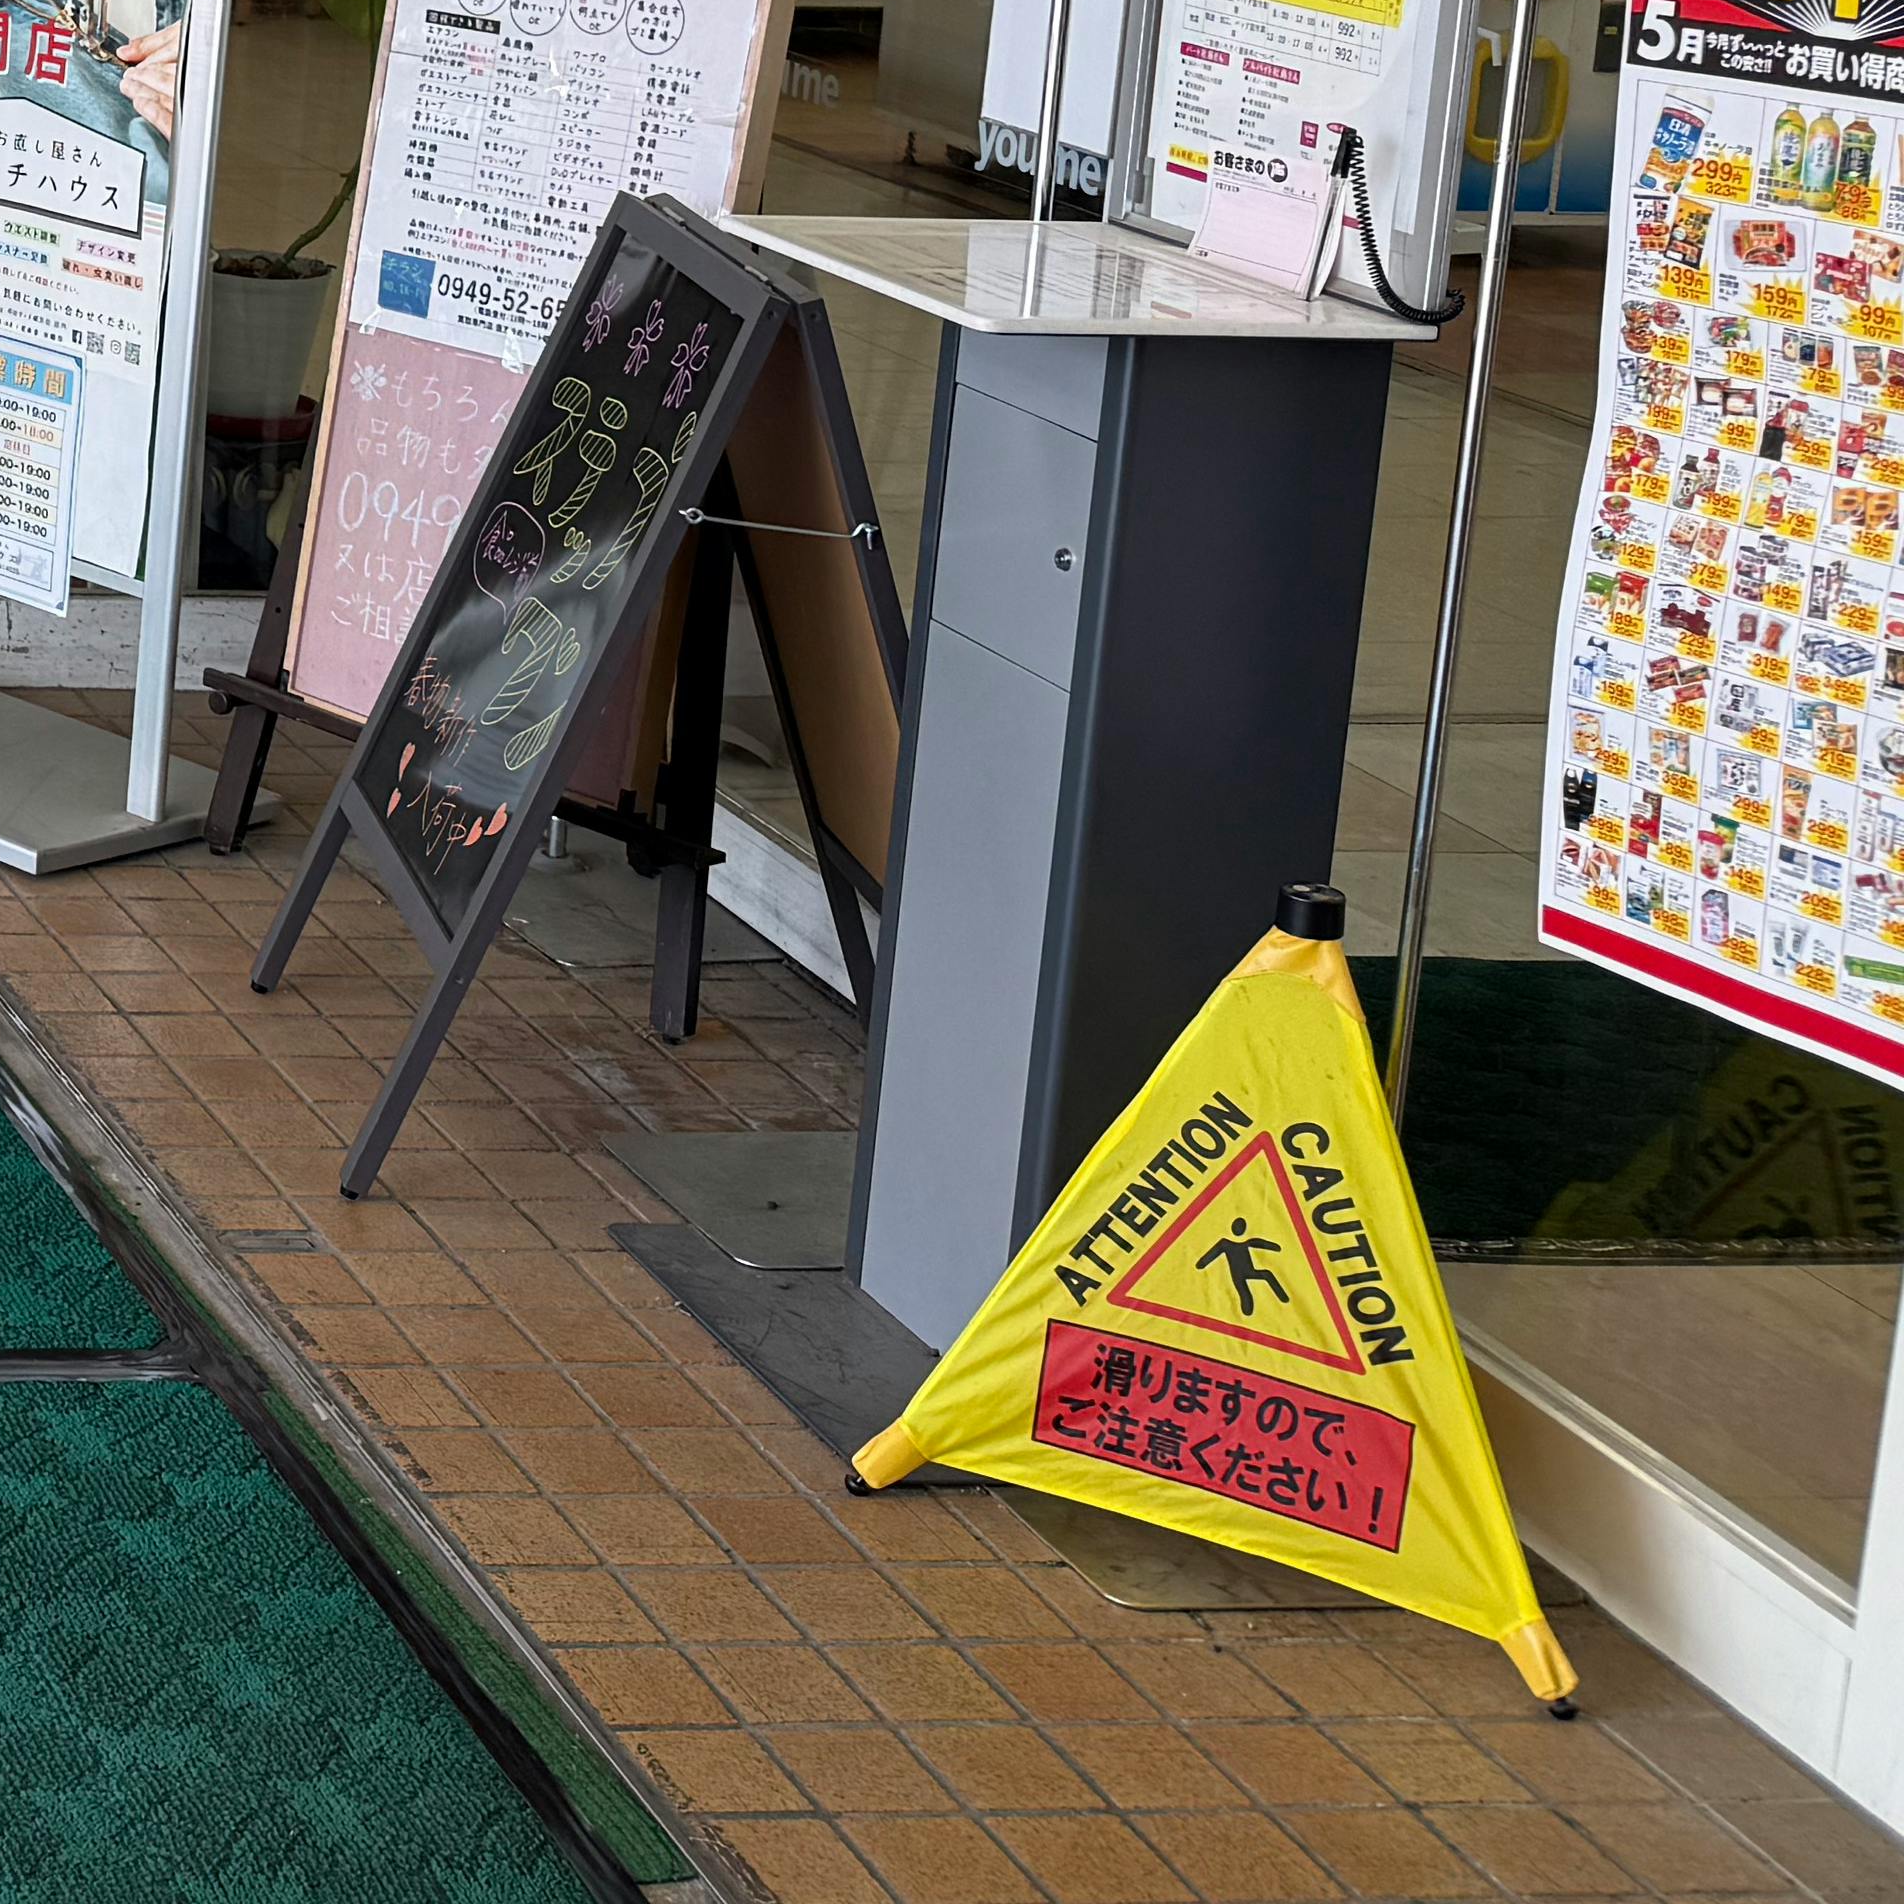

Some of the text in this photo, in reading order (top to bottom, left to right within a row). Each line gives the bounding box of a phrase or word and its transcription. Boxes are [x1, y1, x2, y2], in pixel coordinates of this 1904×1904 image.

[1720, 52, 1774, 75] この安さ!!
[1214, 150, 1265, 175] お客さまの
[1692, 157, 1743, 185] 299円
[1660, 264, 1705, 290] 139円
[1753, 282, 1798, 309] 159円
[1858, 305, 1896, 328] 99円
[1053, 1090, 1254, 1307] ATTENTION
[1281, 1120, 1415, 1366] CAUTION
[1092, 1342, 1359, 1469] 滑りますので、
[1051, 1392, 1383, 1536] ご注意ください!
